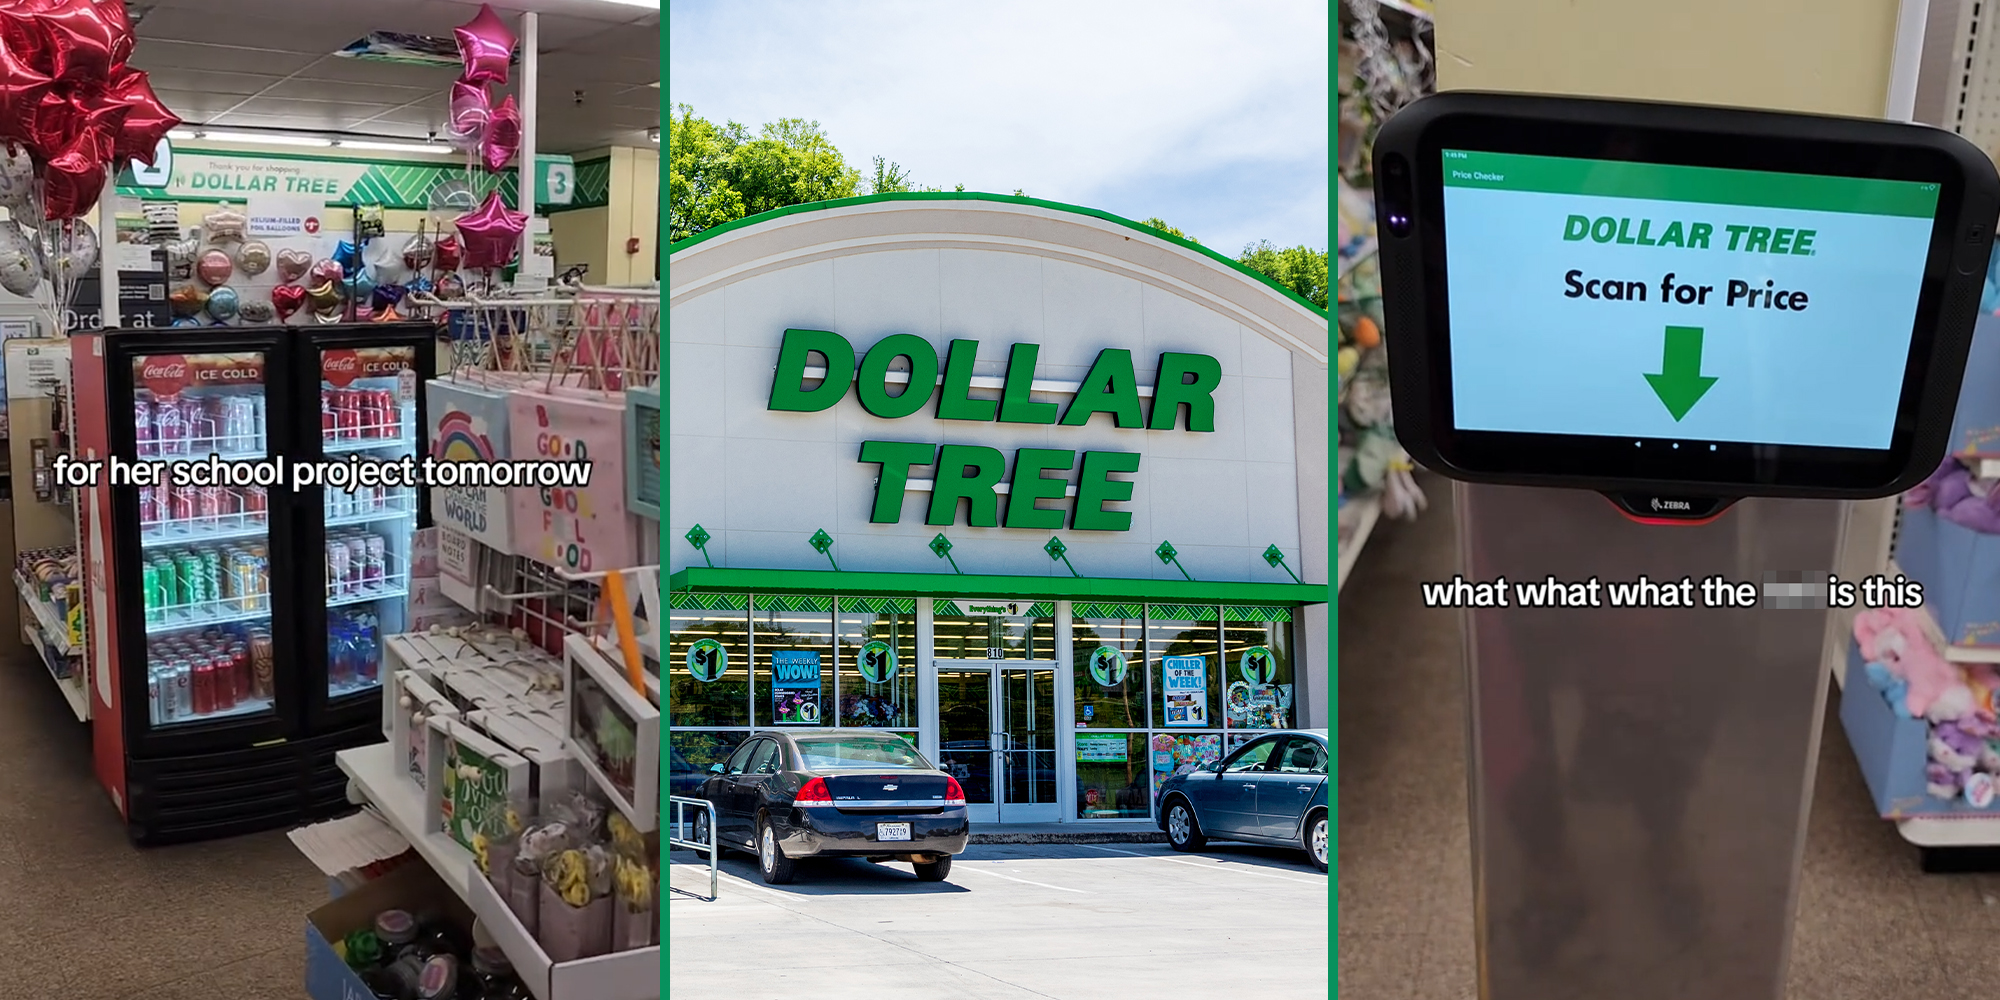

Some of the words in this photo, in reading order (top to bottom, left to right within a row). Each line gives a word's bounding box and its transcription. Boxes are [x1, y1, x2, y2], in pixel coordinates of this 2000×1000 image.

[208, 162, 232, 171] Thank
[266, 165, 300, 174] shopping
[1452, 170, 1472, 180] Price
[1473, 171, 1504, 182] Checker
[191, 172, 278, 192] DOLLAR
[285, 177, 339, 194] TREE
[554, 171, 566, 195] 3
[1563, 215, 1713, 249] DOLLAR
[1564, 270, 1647, 301] Scan
[1661, 273, 1713, 305] for
[1727, 279, 1808, 311] Price
[63, 308, 127, 330] Ordr
[133, 310, 155, 329] at
[143, 363, 186, 379] Coca-Cola
[195, 369, 218, 380] ICE
[222, 368, 258, 379] COLD
[323, 357, 356, 371] Coca-Cola
[363, 362, 380, 372] ICE
[382, 361, 409, 371] COLD
[768, 329, 1222, 432] DOLLAR
[858, 440, 1141, 531] TREE
[1663, 501, 1690, 510] ZEBRA
[445, 499, 487, 533] WORLD
[442, 531, 467, 550] BOARD
[442, 544, 465, 562] NOTES
[969, 604, 1007, 615] Everything's
[791, 657, 819, 665] WEEKLY
[987, 648, 1003, 658] 810
[695, 647, 718, 681] $1
[775, 664, 819, 681] WOW!
[865, 650, 888, 682] $1
[1097, 654, 1119, 686] $1
[1167, 659, 1201, 670] CHILLER
[1174, 669, 1182, 677] OF
[1184, 669, 1195, 677] THE
[1247, 654, 1268, 685] $1
[1168, 676, 1202, 689] WEEK!
